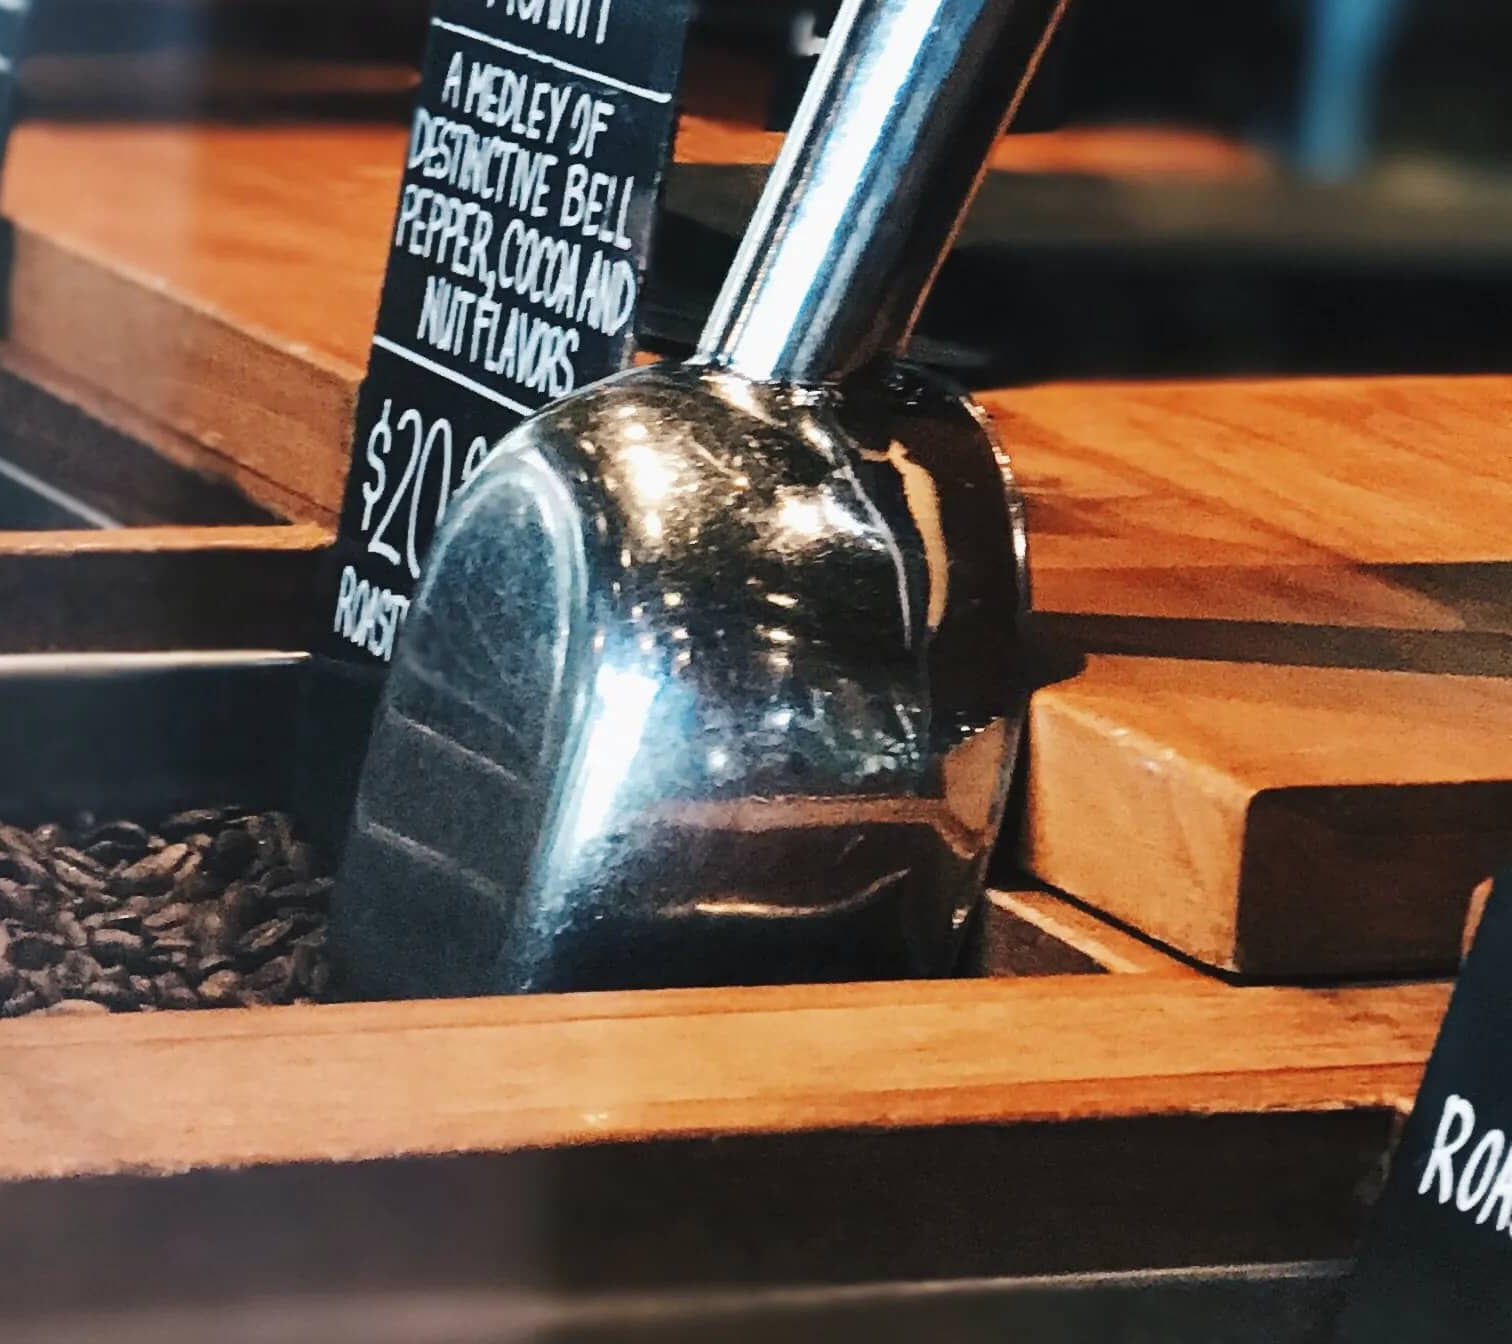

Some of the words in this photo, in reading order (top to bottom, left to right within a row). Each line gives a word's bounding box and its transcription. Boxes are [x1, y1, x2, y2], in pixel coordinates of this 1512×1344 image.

[440, 51, 464, 109] A
[463, 61, 573, 145] MEDLEY
[567, 92, 616, 159] OF
[559, 163, 635, 251] BELL
[416, 275, 477, 357] NUT
[469, 296, 580, 399] FLAVORS
[498, 218, 582, 319] COCOA
[575, 249, 637, 337] AND
[1417, 1093, 1512, 1239] ROA
